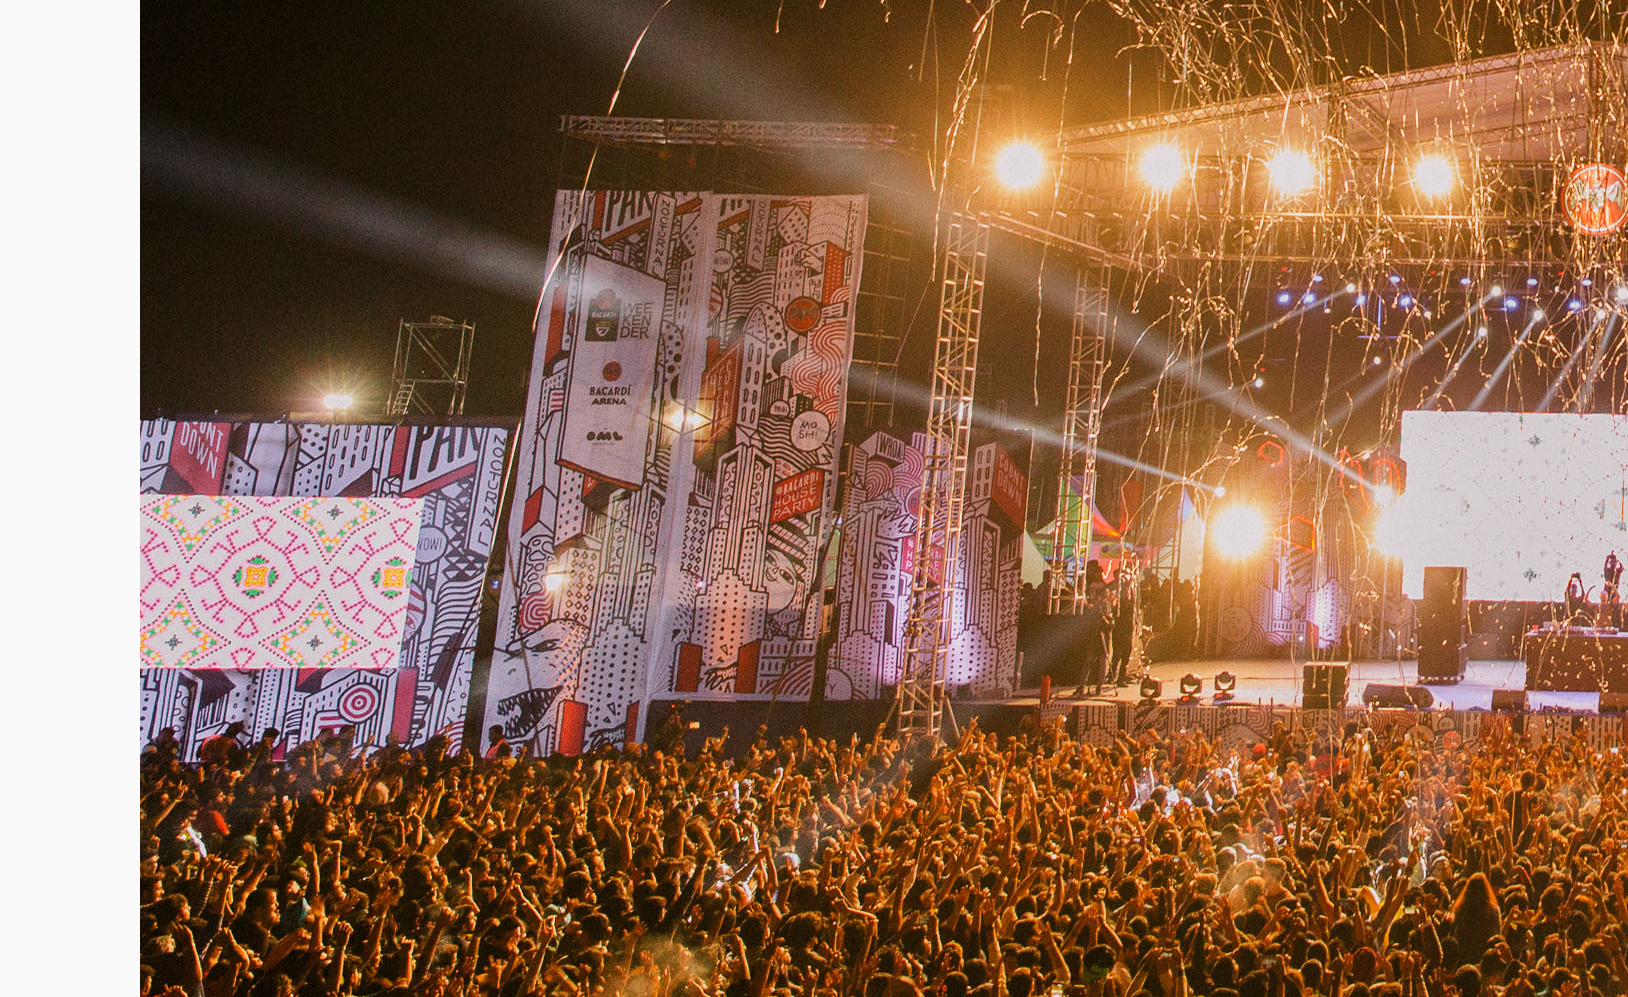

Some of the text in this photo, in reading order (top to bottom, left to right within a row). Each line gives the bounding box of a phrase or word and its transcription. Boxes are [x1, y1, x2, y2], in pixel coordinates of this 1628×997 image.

[651, 199, 671, 277] NOCTURNAL
[751, 200, 768, 264] OCTURNAL
[620, 326, 650, 339] DER
[623, 315, 652, 327] KEN
[589, 384, 632, 397] BACARDÍ
[591, 397, 628, 406] ARENA
[800, 421, 818, 430] MO
[181, 421, 218, 479] DOWN
[478, 434, 506, 547] NOCTURNAL
[774, 484, 817, 508] HOUSE
[998, 469, 1022, 509] DOWN
[773, 494, 817, 521] PARTY
